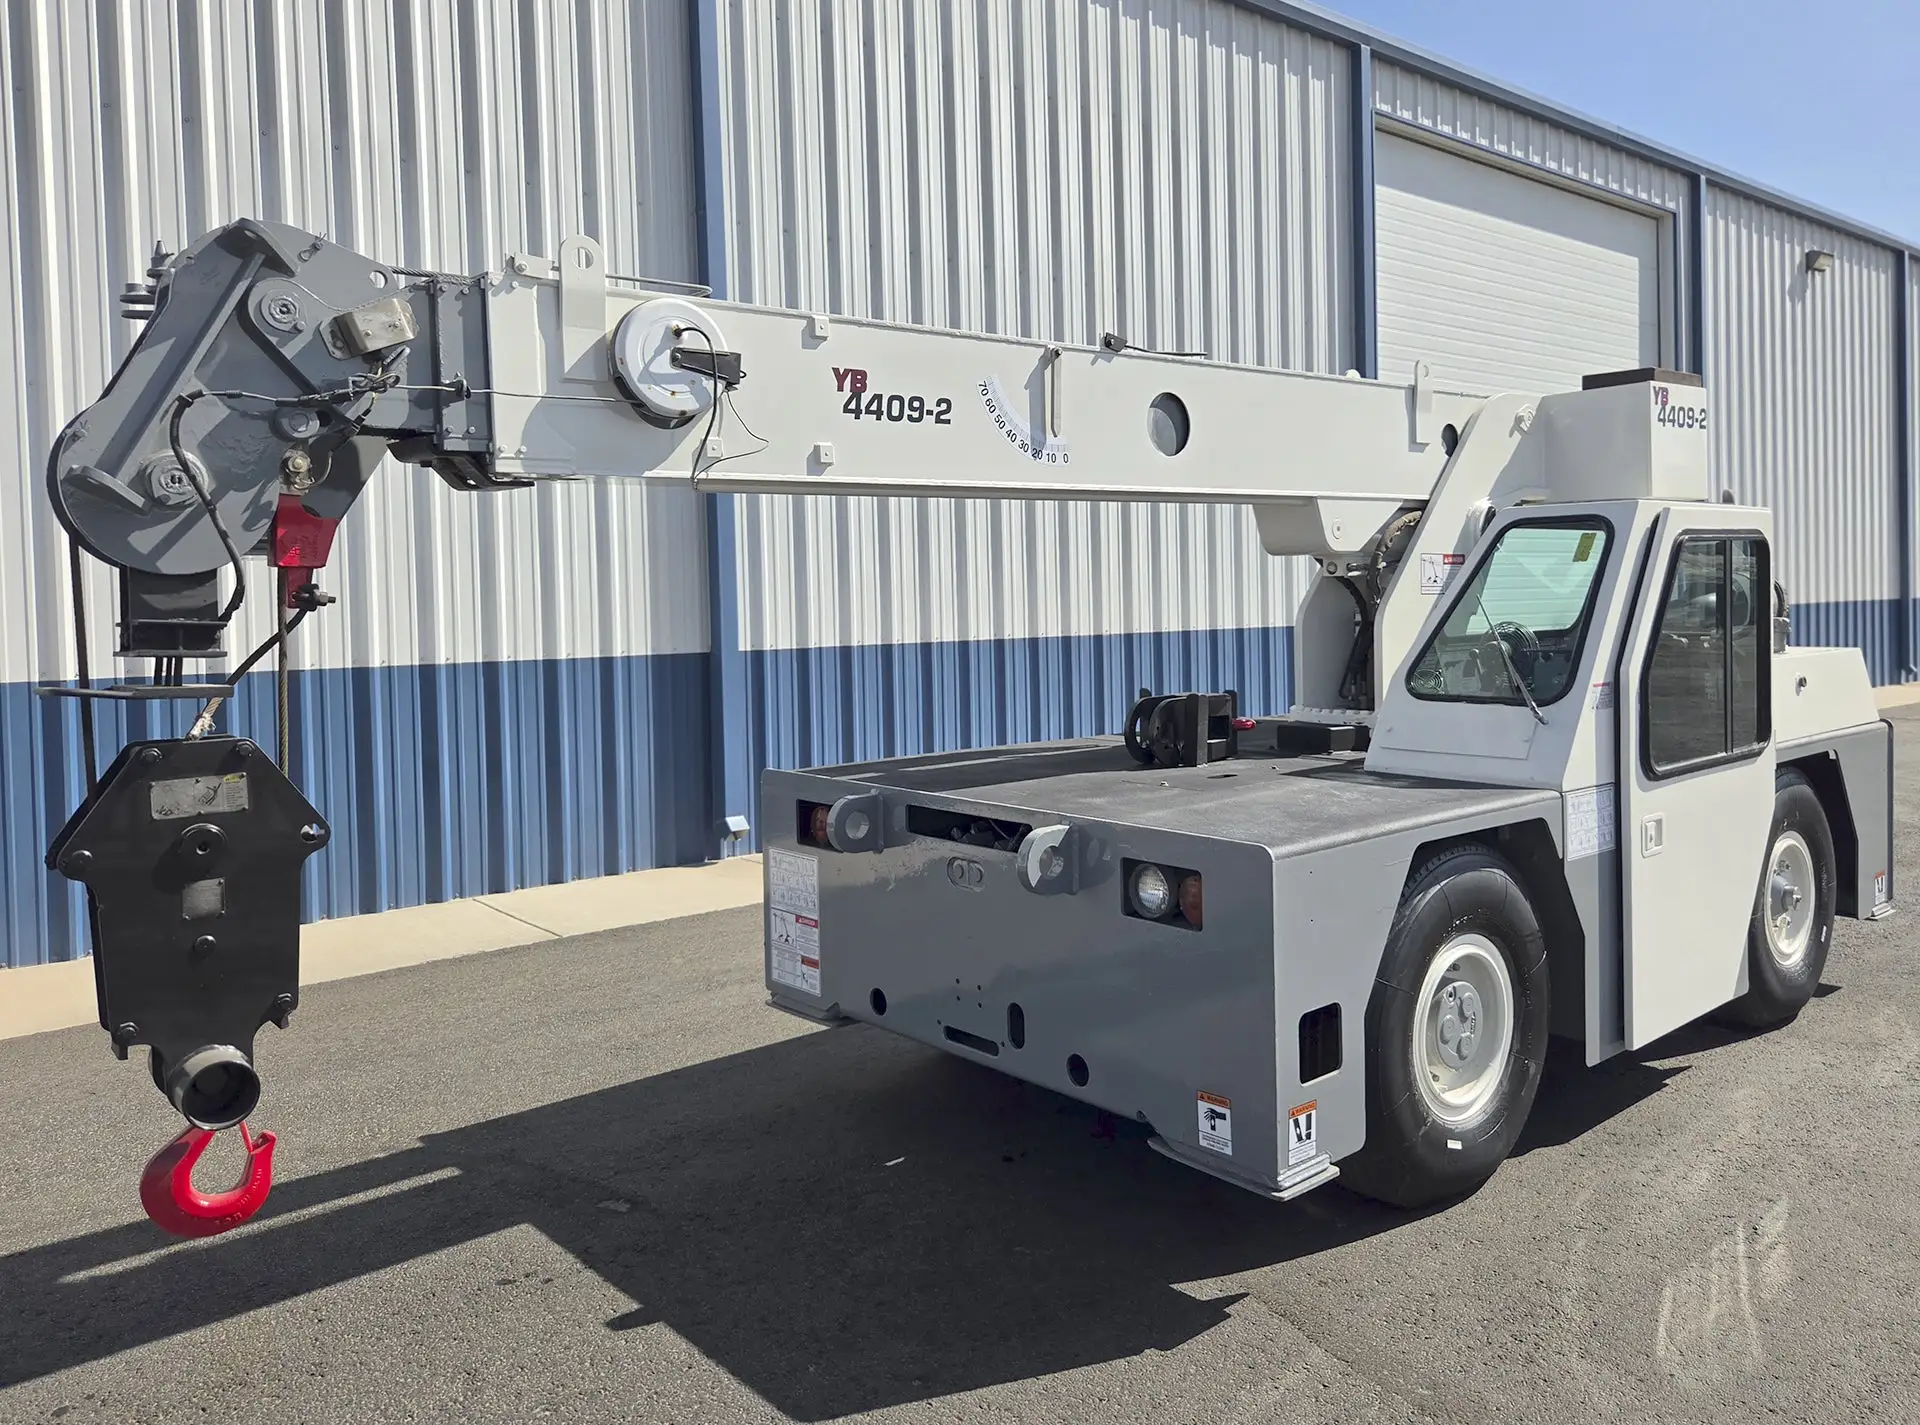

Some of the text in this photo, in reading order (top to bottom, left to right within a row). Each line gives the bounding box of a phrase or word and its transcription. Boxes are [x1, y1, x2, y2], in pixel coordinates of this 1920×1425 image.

[831, 367, 868, 393] YB
[842, 392, 953, 424] 4409-2
[1652, 385, 1669, 406] YB
[978, 380, 1069, 464] 70 60 50 40 30 20 10 0
[1657, 405, 1707, 430] 4409-2
